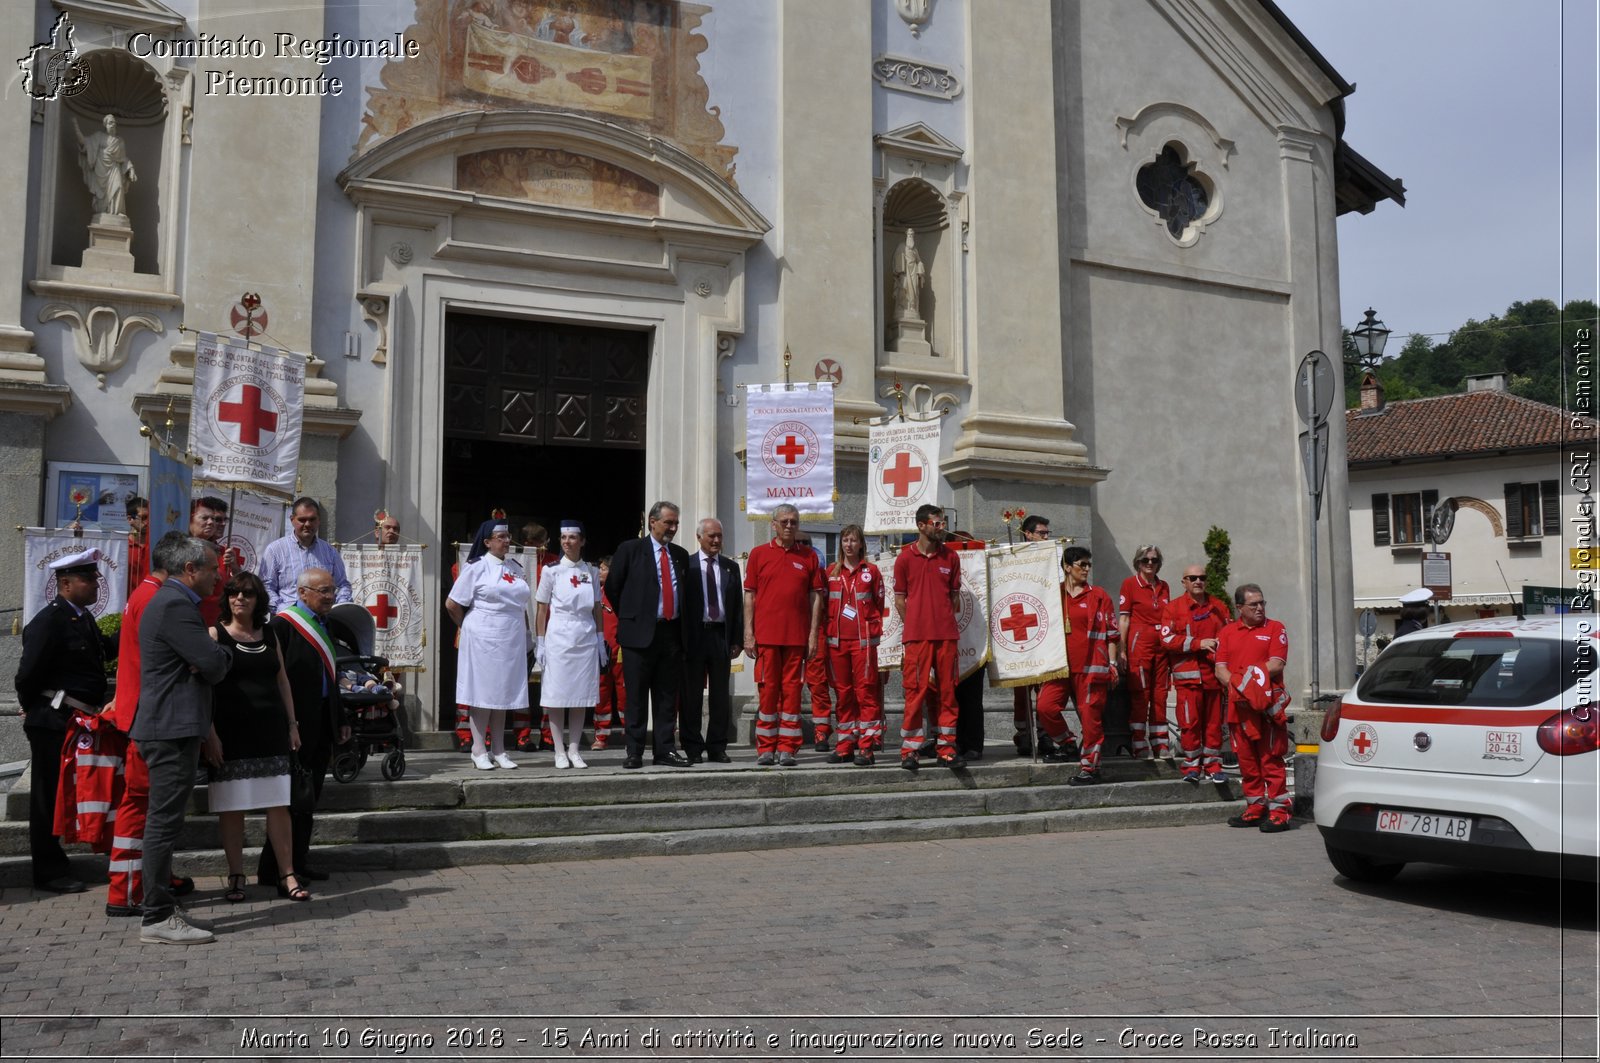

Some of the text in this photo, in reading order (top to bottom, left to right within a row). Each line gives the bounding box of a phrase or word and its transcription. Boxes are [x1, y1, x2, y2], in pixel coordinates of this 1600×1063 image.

[198, 356, 304, 385] CROCE ROSSA ITALIANA
[913, 432, 940, 440] ITALIANA
[207, 454, 270, 470] DELEGAZIONE
[210, 465, 279, 482] PEVERAGNO
[766, 488, 814, 498] MANTA
[37, 550, 60, 570] CROCE
[362, 570, 392, 580] ROSSA
[998, 572, 1021, 584] ROSSA
[1004, 659, 1046, 671] CENTALLO
[1488, 732, 1518, 743] CN 12
[1489, 744, 1518, 754] 20-43
[1482, 754, 1524, 762] Bravo
[1379, 810, 1467, 838] CRI 781 AB
